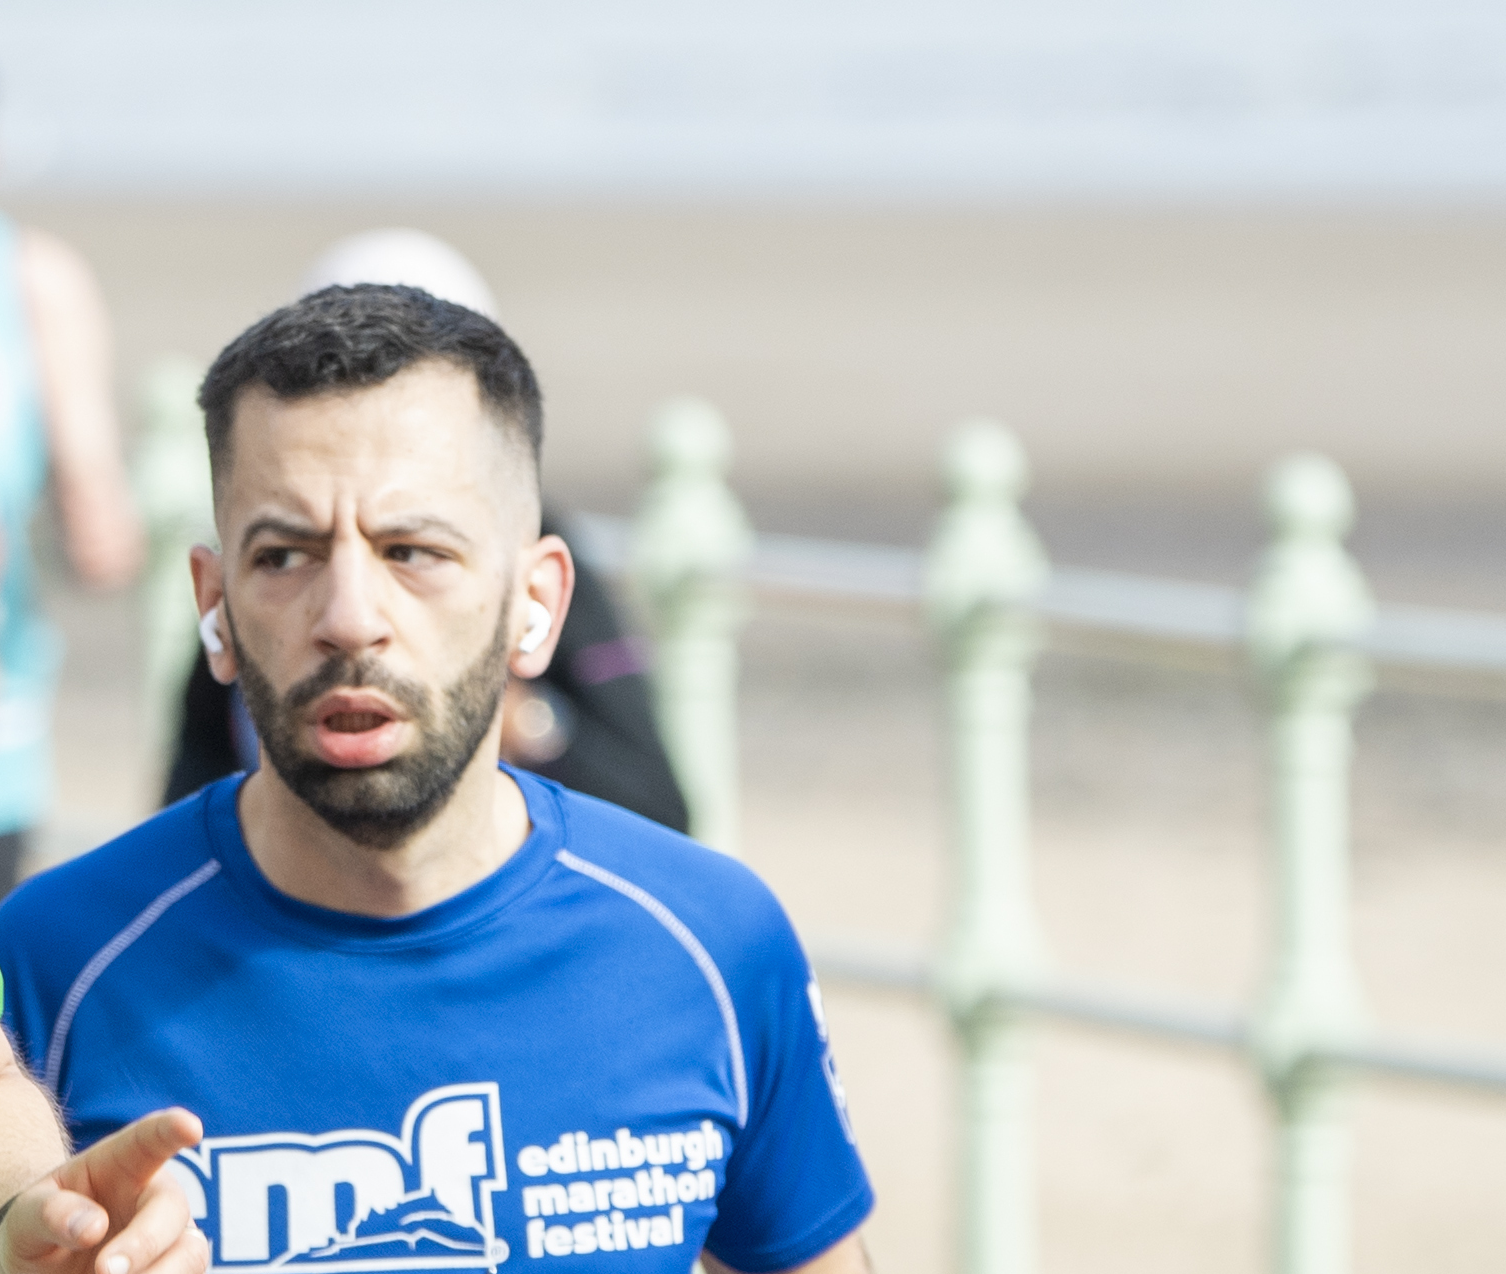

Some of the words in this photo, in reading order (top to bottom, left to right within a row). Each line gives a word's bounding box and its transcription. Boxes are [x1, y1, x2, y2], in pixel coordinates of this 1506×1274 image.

[517, 1119, 725, 1177] edinburgh
[521, 1163, 717, 1217] marathon
[526, 1204, 686, 1259] festival
